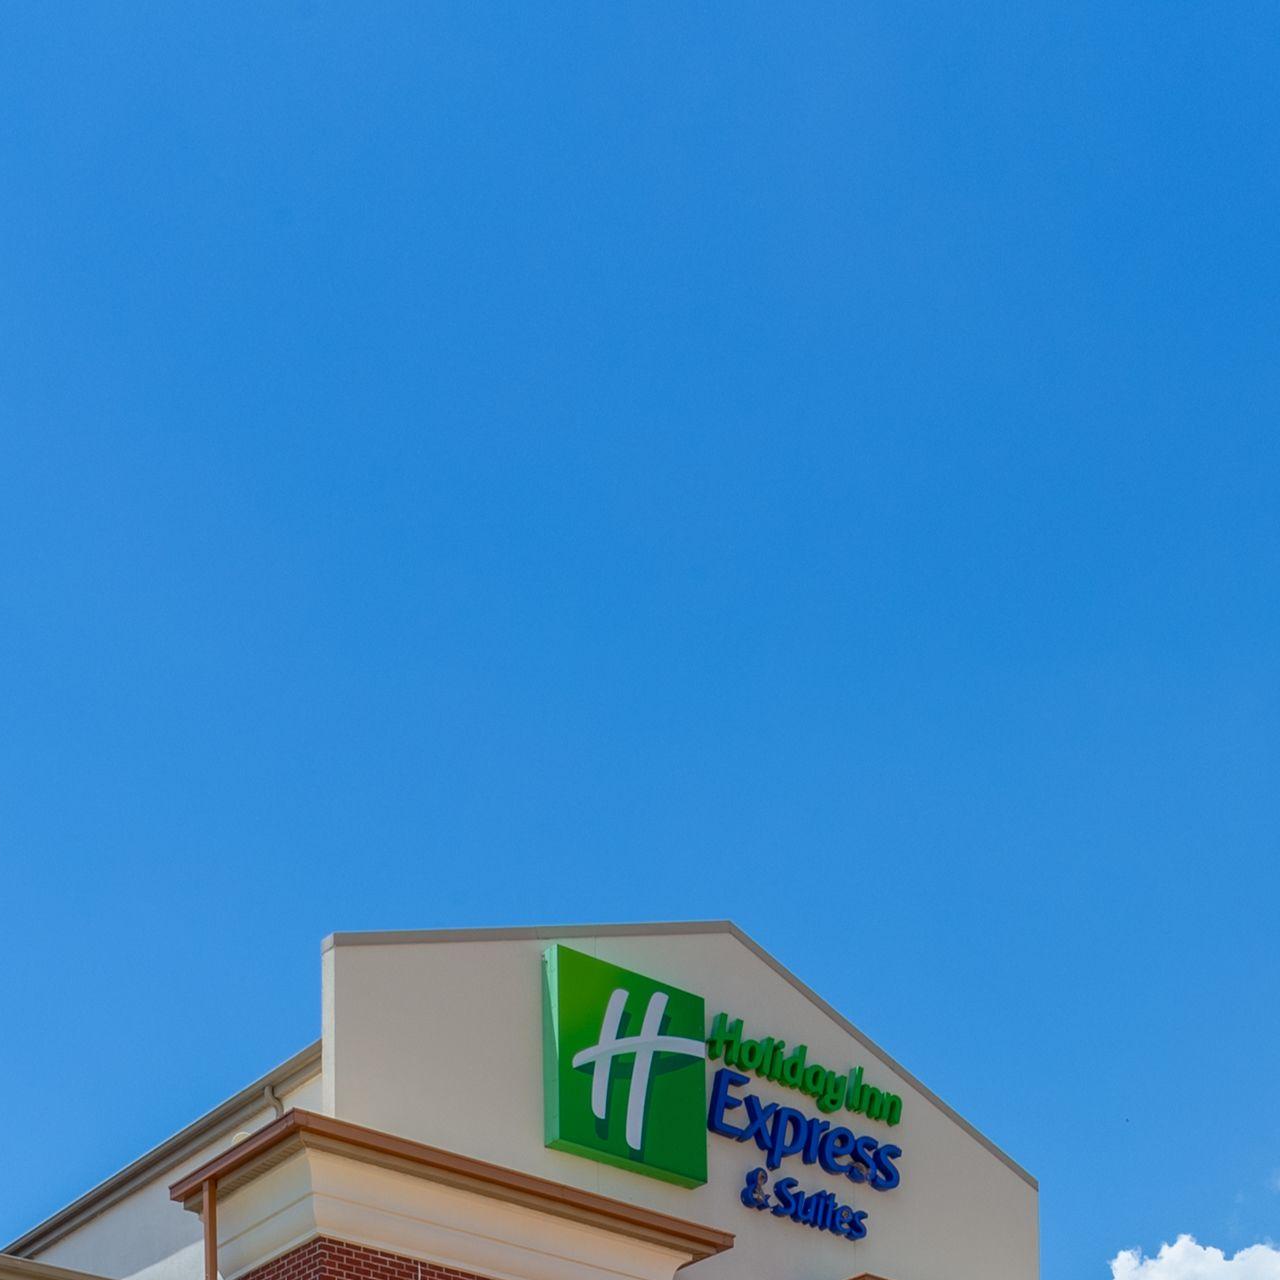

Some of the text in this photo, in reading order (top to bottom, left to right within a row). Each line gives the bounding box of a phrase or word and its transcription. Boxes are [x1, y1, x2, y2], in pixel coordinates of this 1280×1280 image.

[706, 1012, 902, 1127] Holiday Inn
[707, 1068, 902, 1192] Express
[740, 1167, 868, 1241] & Suites
